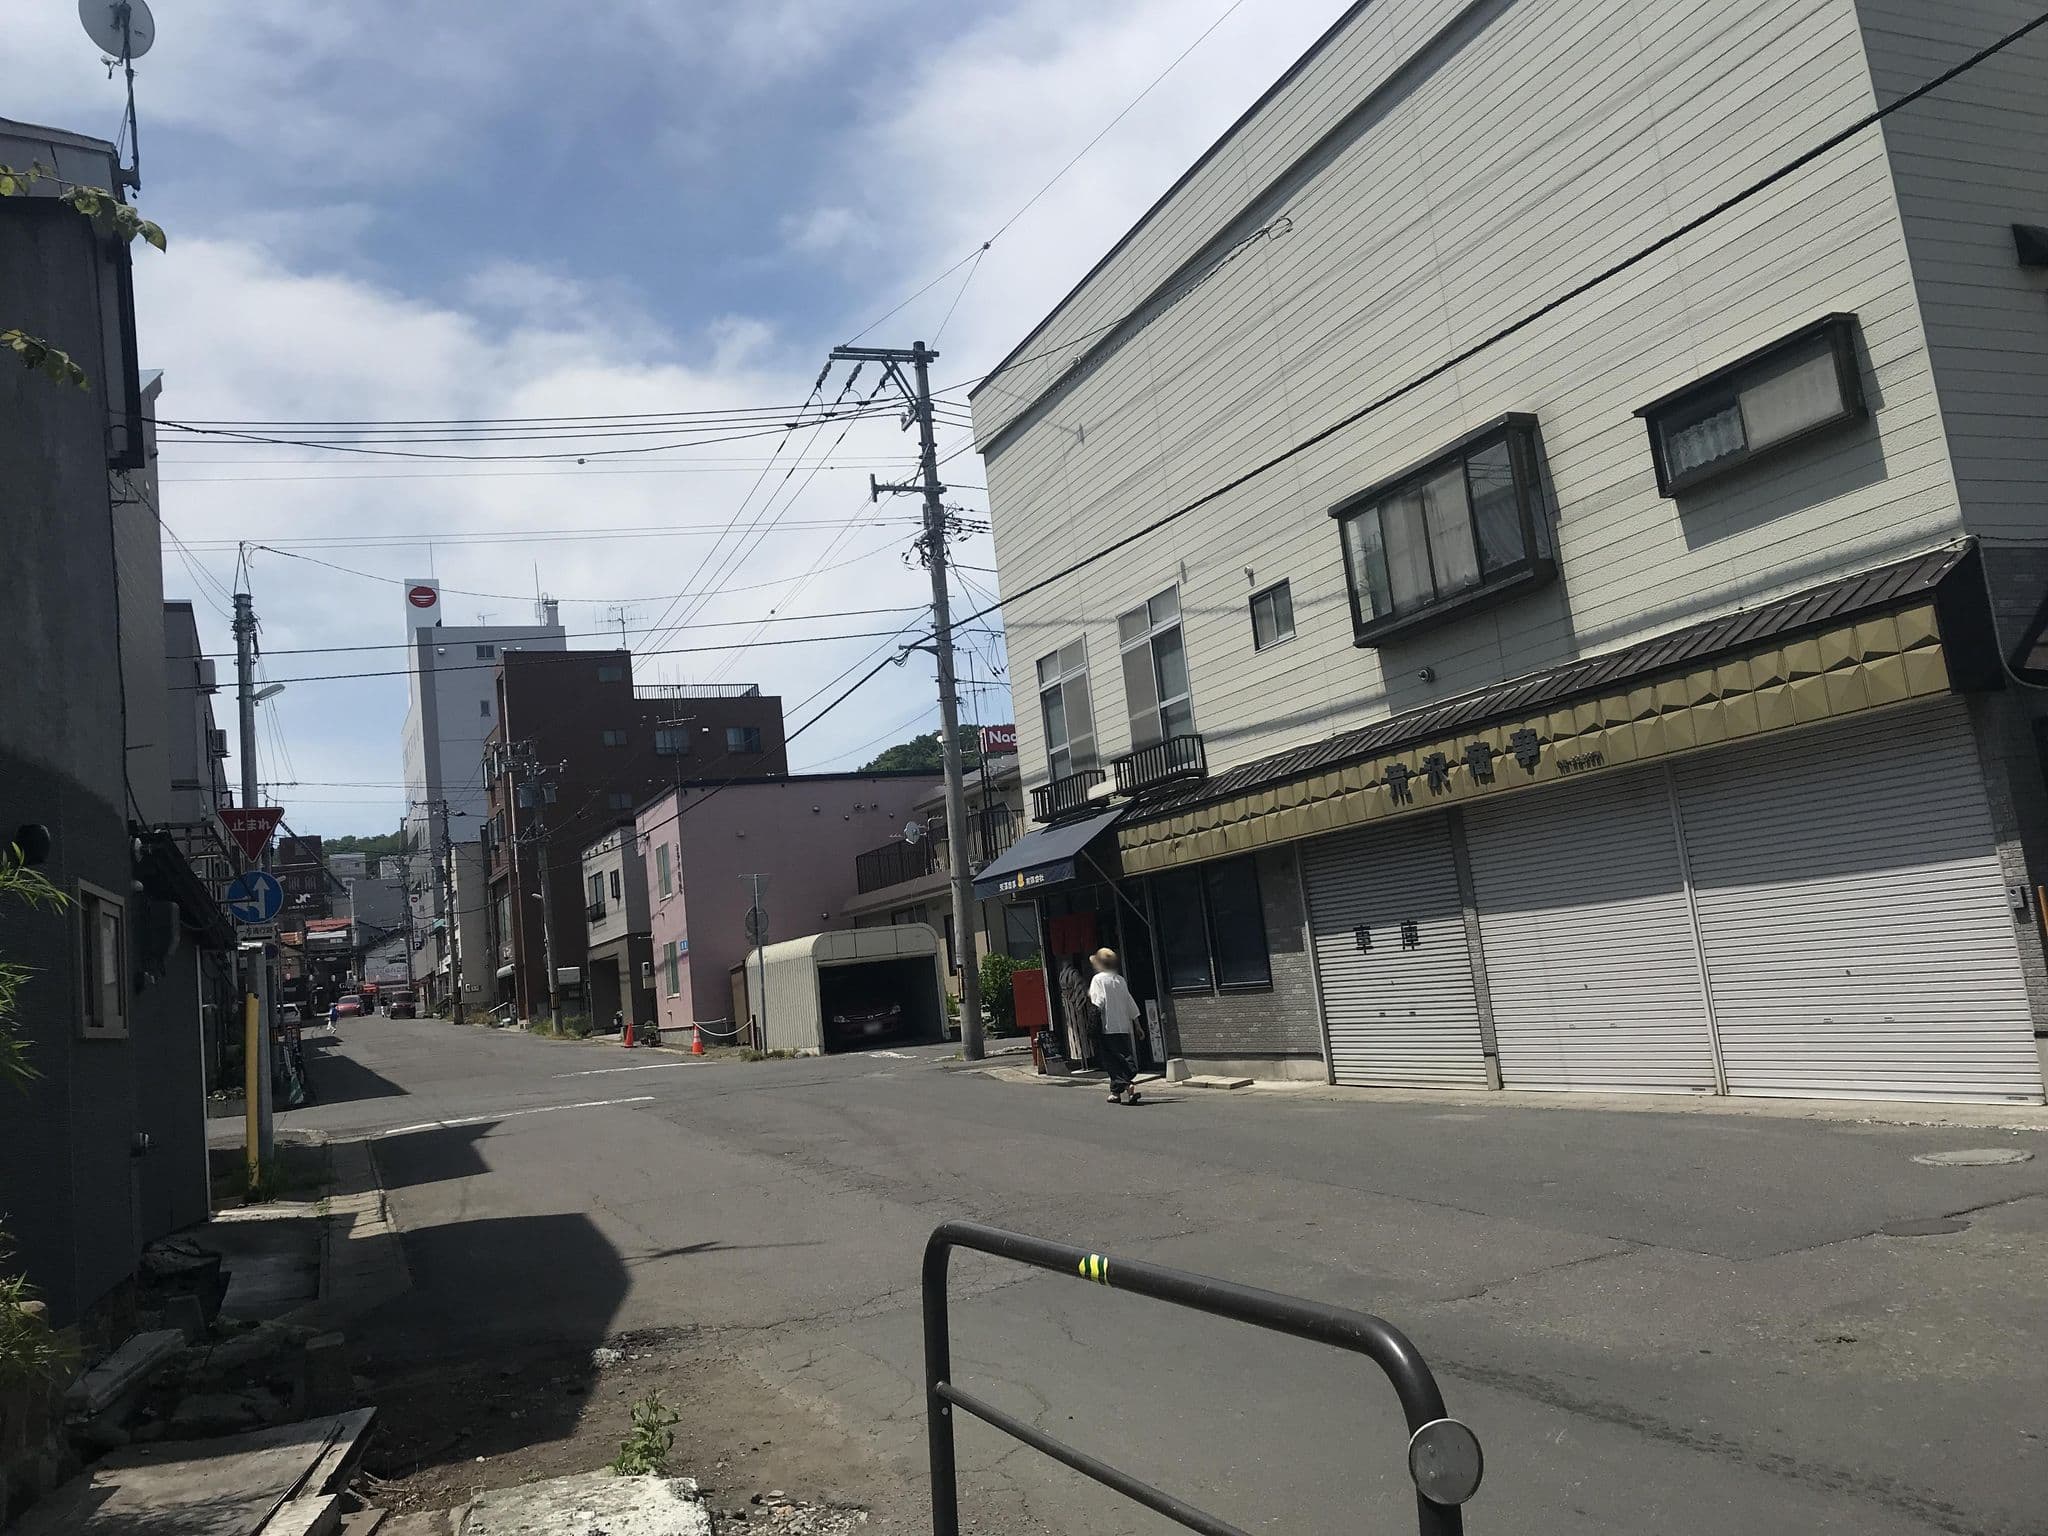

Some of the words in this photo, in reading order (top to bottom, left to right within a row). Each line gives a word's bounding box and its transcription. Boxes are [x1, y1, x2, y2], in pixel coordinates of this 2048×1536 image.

[232, 819, 271, 832] 止まれ
[1353, 919, 1422, 955] 車庫
